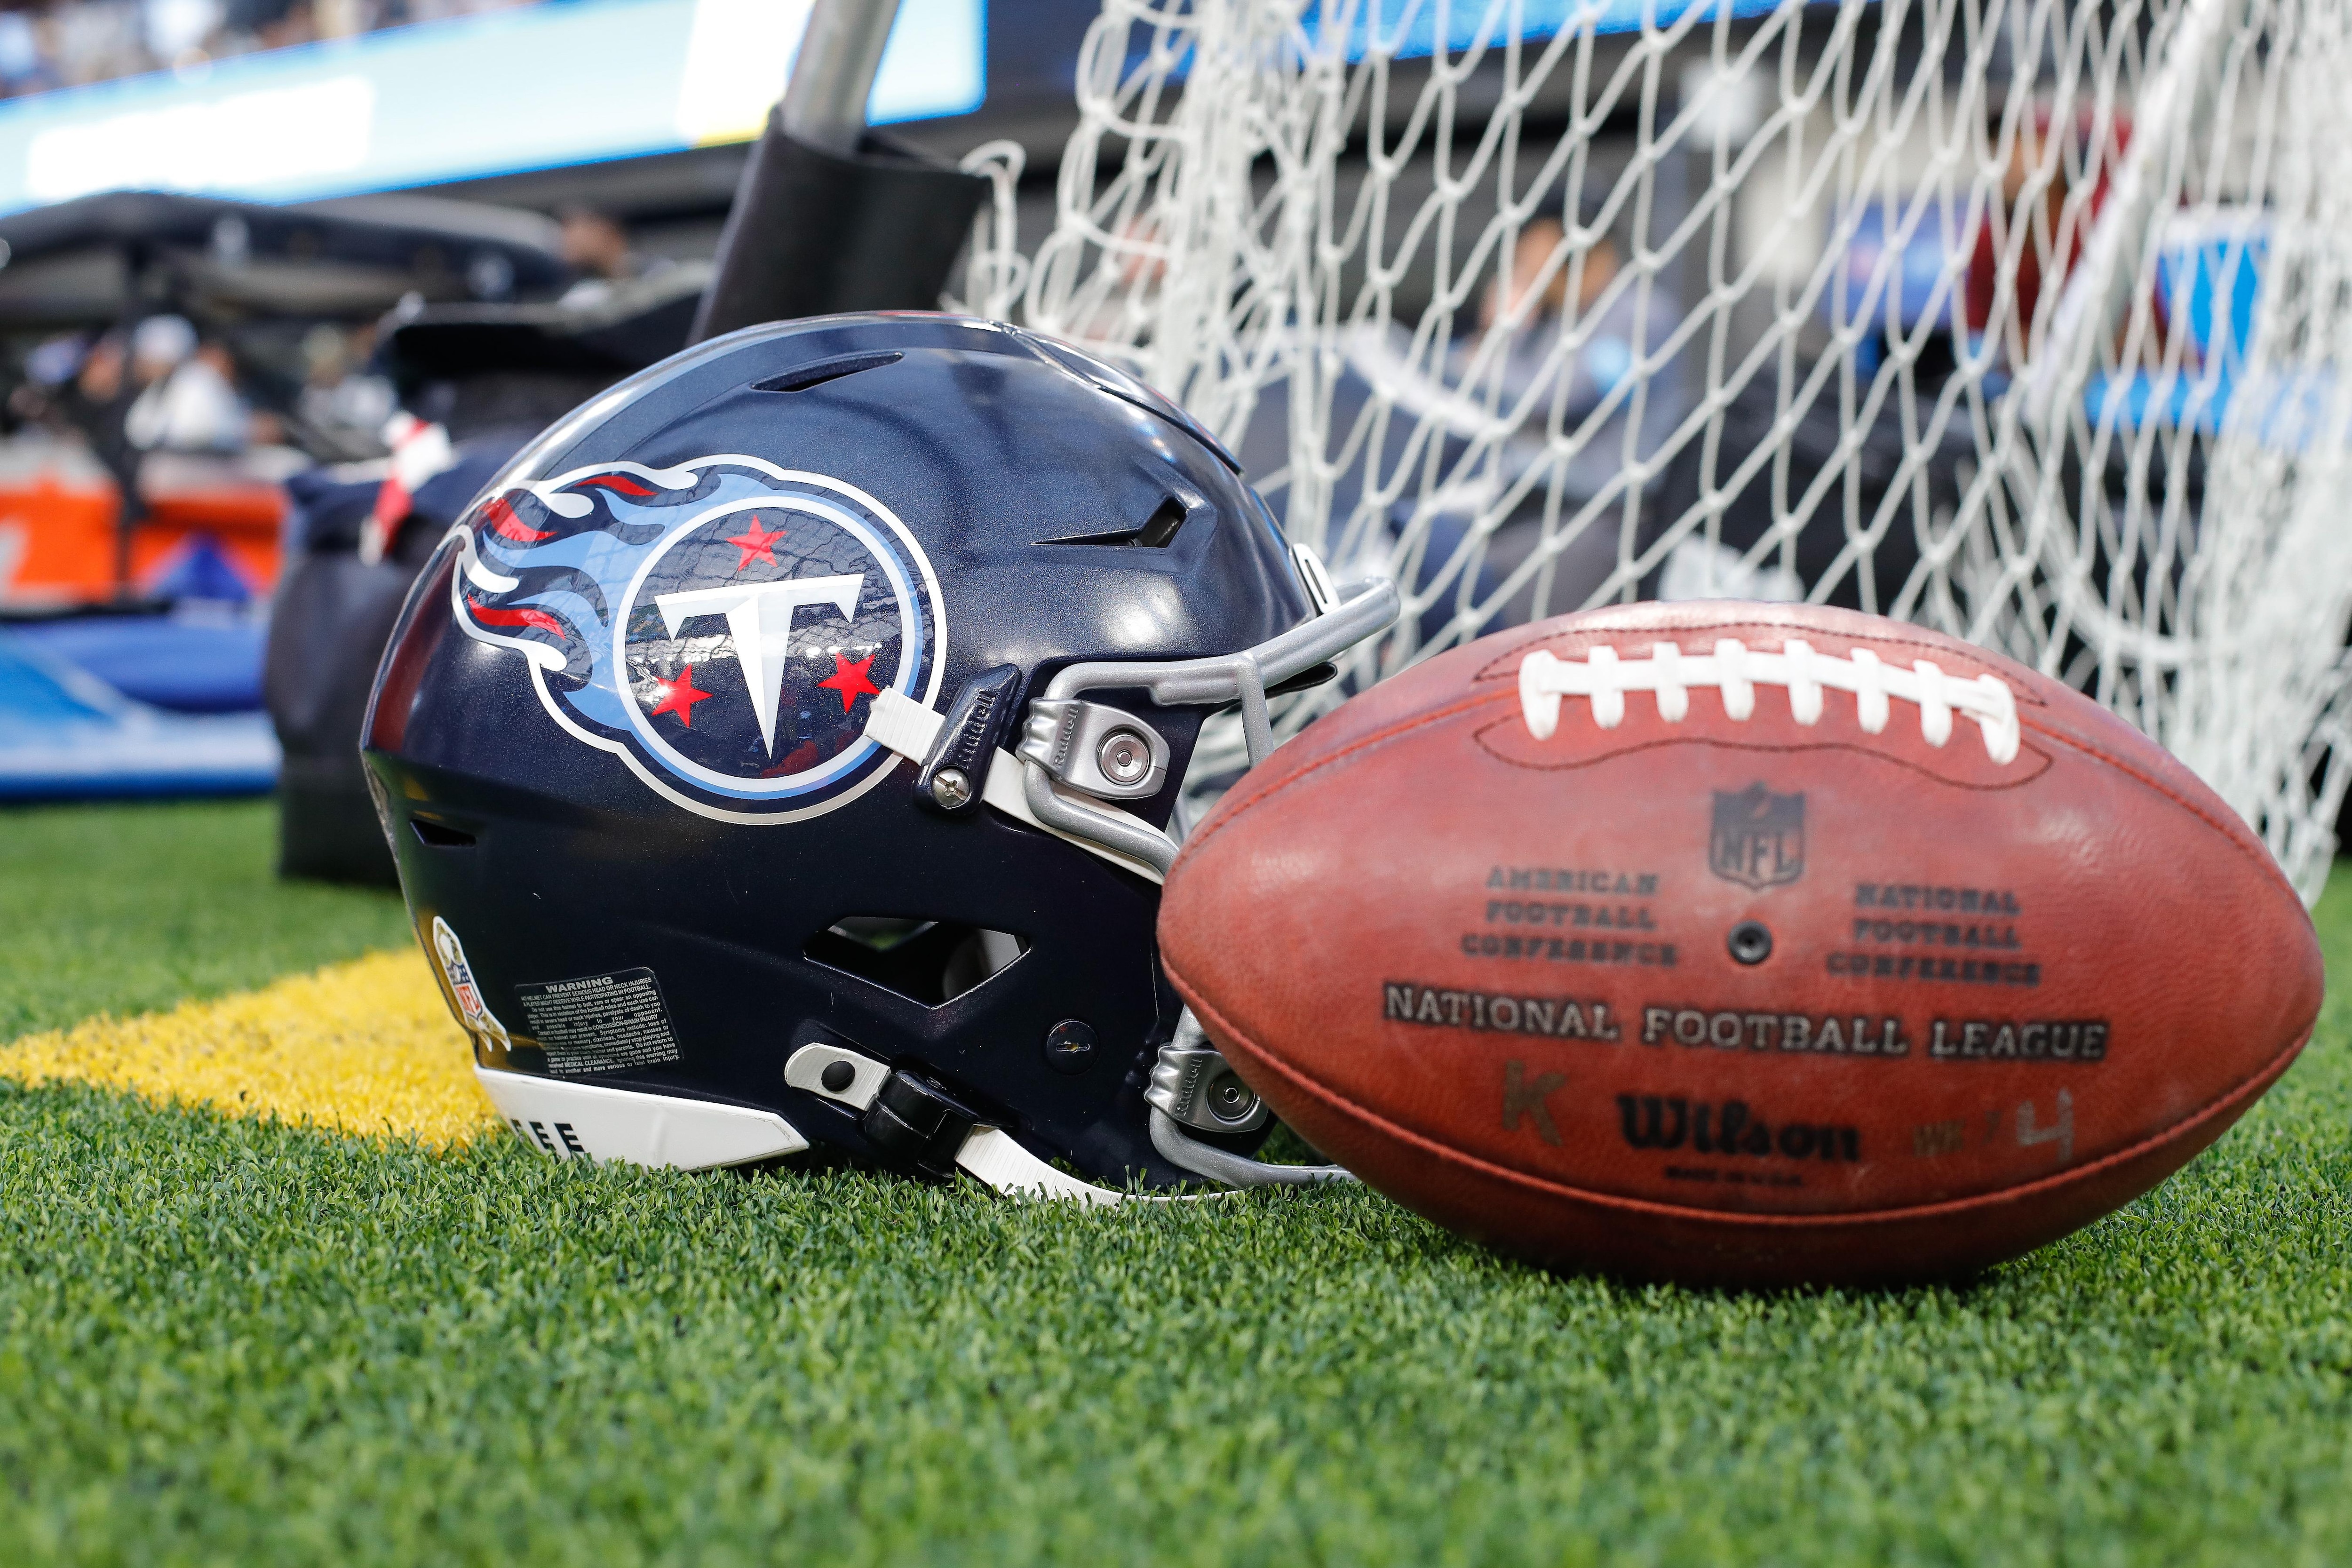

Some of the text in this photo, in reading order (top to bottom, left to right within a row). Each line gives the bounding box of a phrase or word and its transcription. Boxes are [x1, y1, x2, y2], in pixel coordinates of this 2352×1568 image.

[1052, 703, 1081, 768] Riddell
[1486, 866, 1659, 896] AMERICAN
[1486, 899, 1657, 931] FOOTBALL
[1854, 918, 2022, 950] FOOTBALL
[545, 977, 613, 993] WARNING
[584, 990, 618, 1001] PARTICIPATING
[628, 977, 652, 986] INJURIES
[633, 990, 656, 999] opposing
[602, 1008, 624, 1017] paralysis
[634, 1007, 662, 1017] opponent.
[640, 1013, 658, 1022] INJURY
[1384, 982, 2110, 1062] NATIONAL FOOTBALL LEAGUE
[1173, 1057, 1203, 1117] Riddell
[1502, 1059, 1566, 1147] K
[1615, 1092, 1860, 1162] Wilson
[2016, 1086, 2075, 1162] 4
